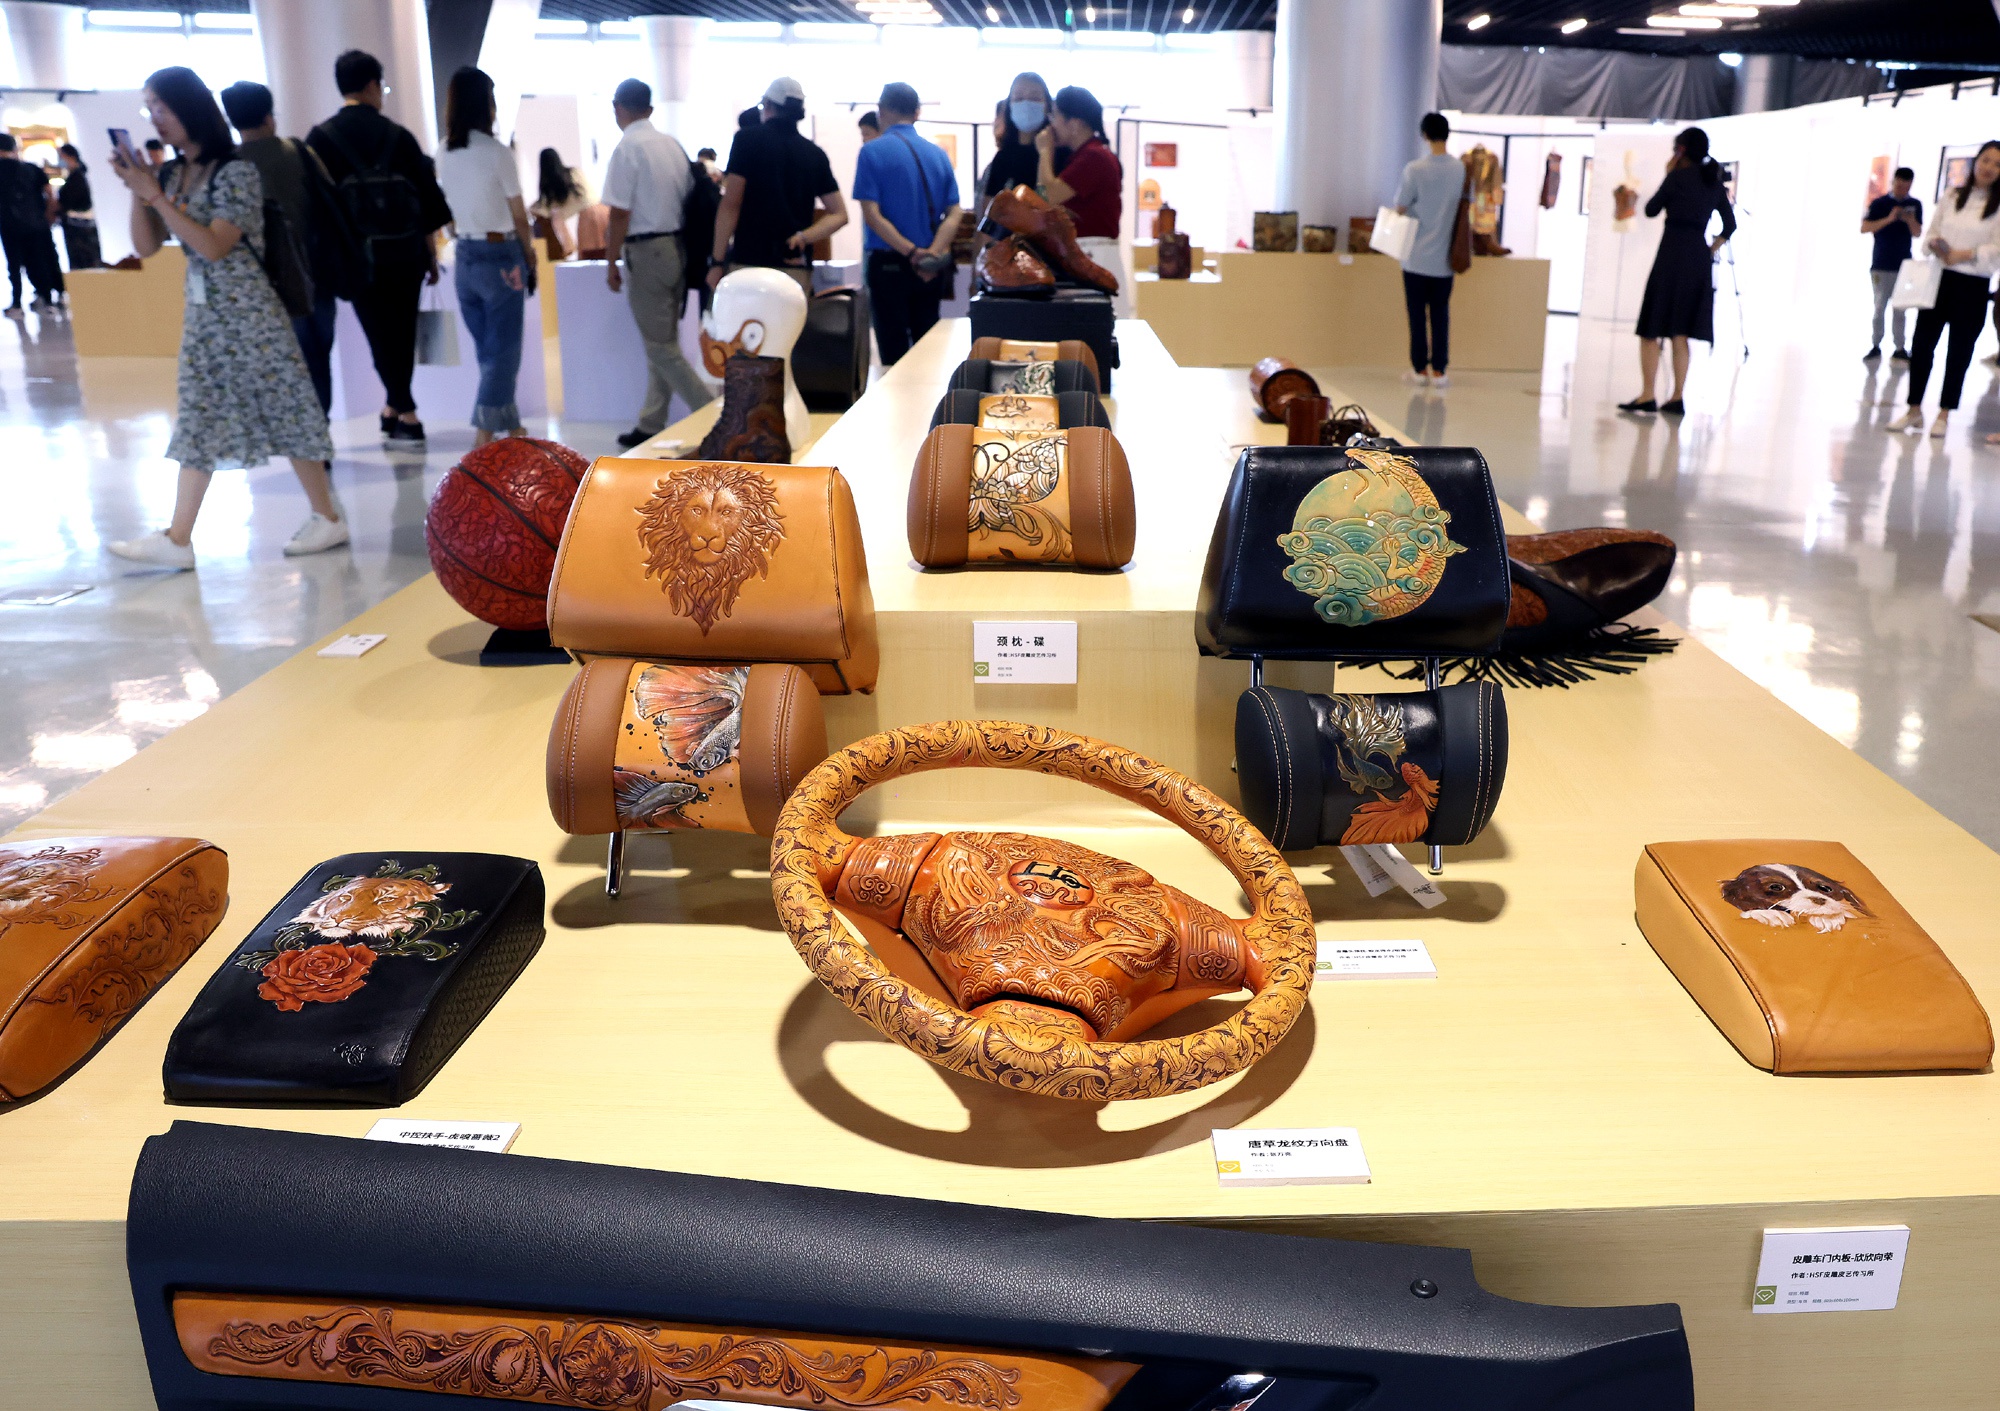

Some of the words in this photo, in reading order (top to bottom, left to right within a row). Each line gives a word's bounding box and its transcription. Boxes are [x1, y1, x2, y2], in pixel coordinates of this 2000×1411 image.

[1248, 1138, 1349, 1149] 唐草龙纹方向盘
[1792, 1251, 1894, 1265] 皮雕车门内板-欣欣向荣
